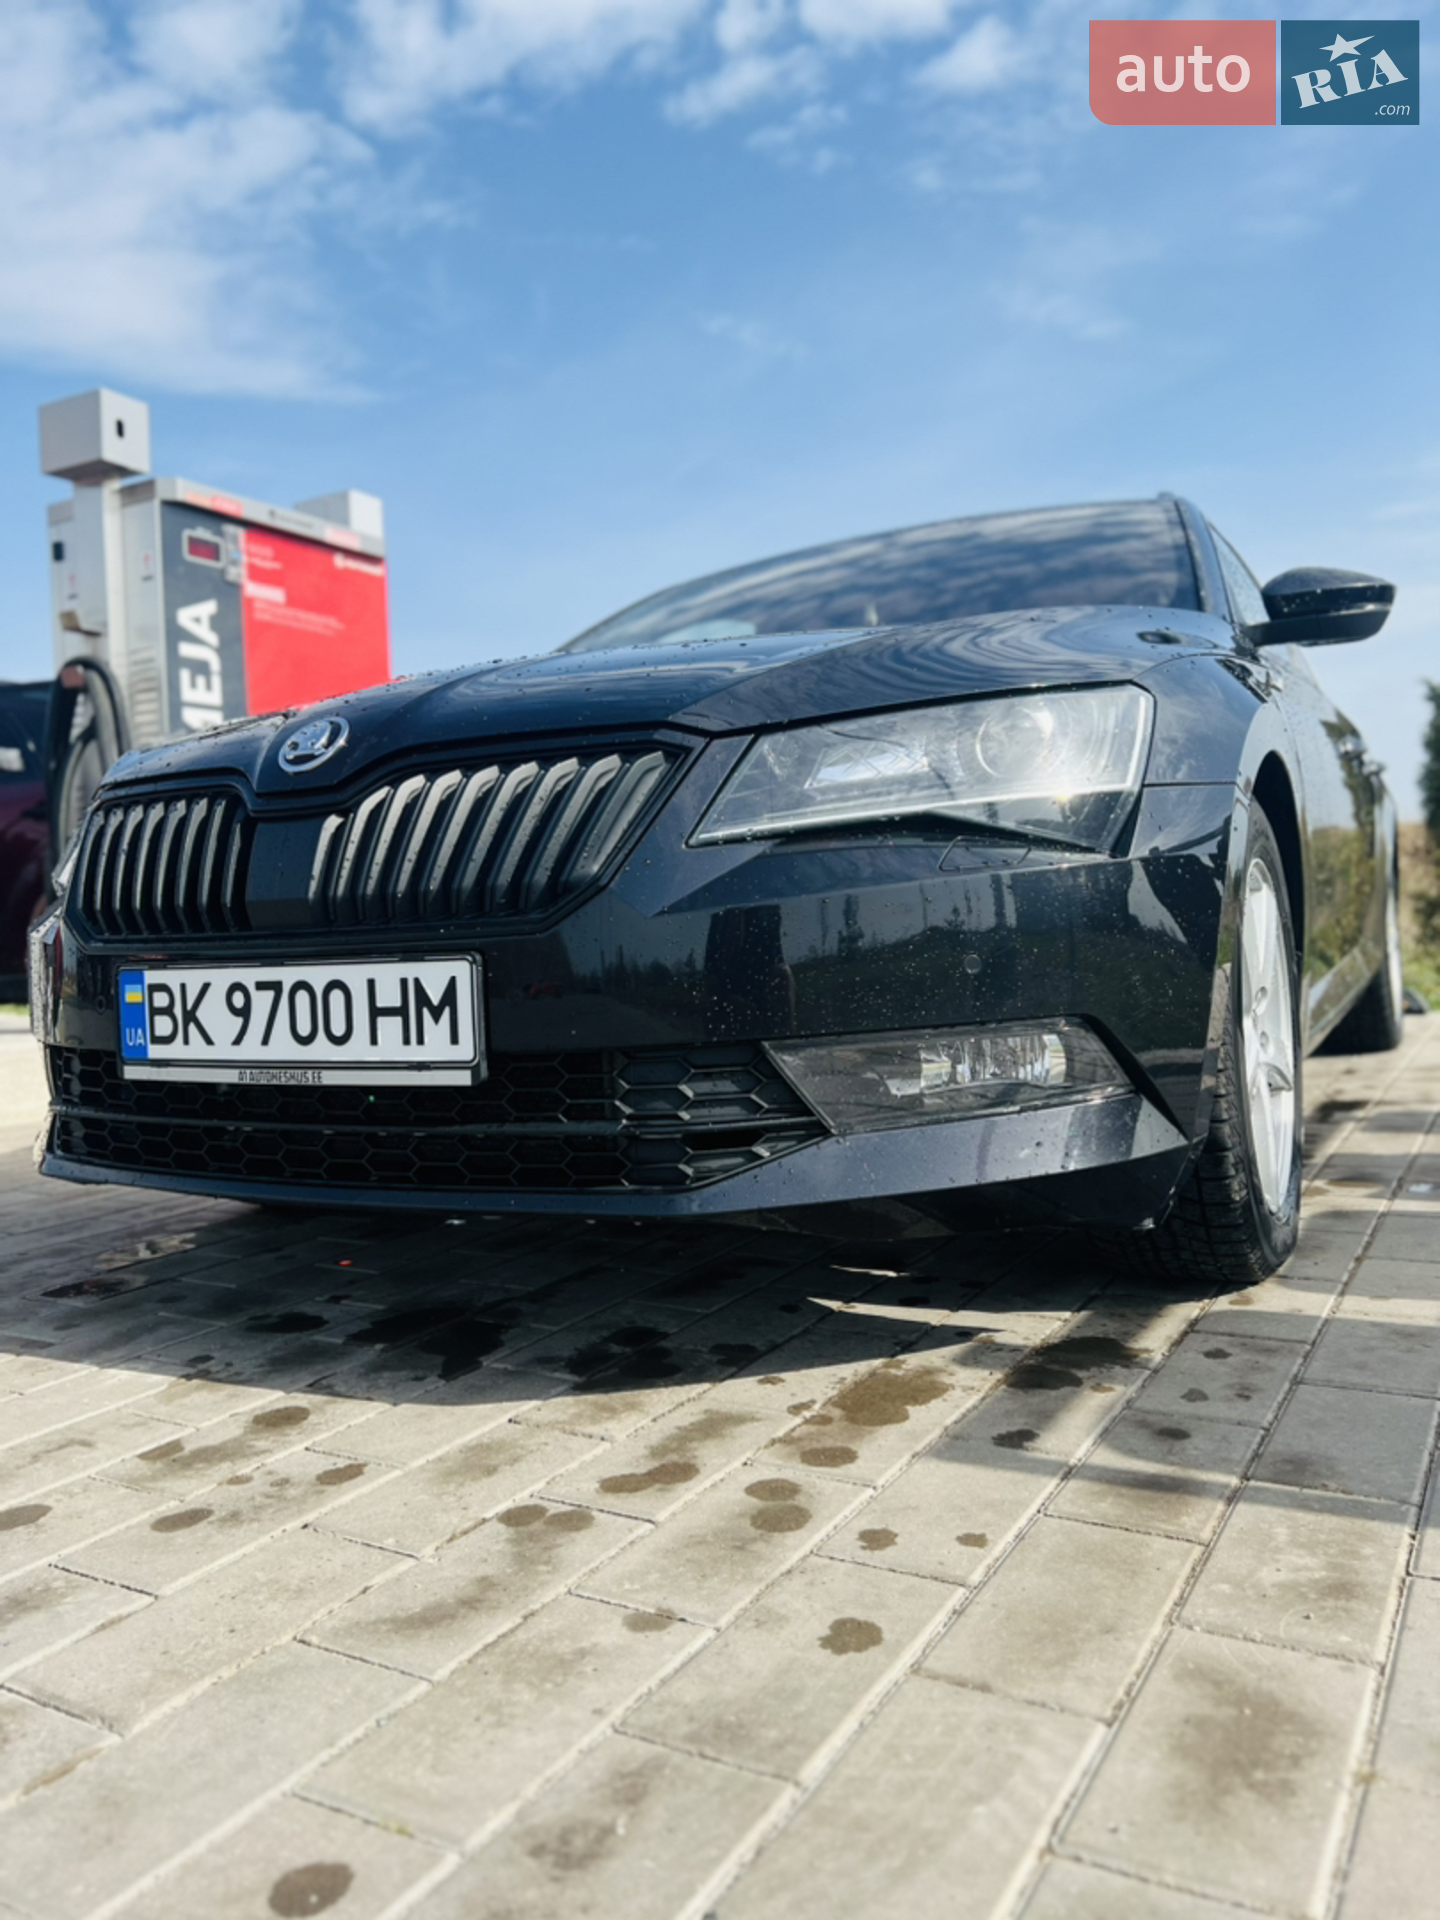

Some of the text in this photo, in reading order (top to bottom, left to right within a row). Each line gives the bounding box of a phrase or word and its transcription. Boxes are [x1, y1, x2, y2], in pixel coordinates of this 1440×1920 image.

[147, 975, 459, 1046] BK 9700 HM
[125, 1027, 145, 1046] UA
